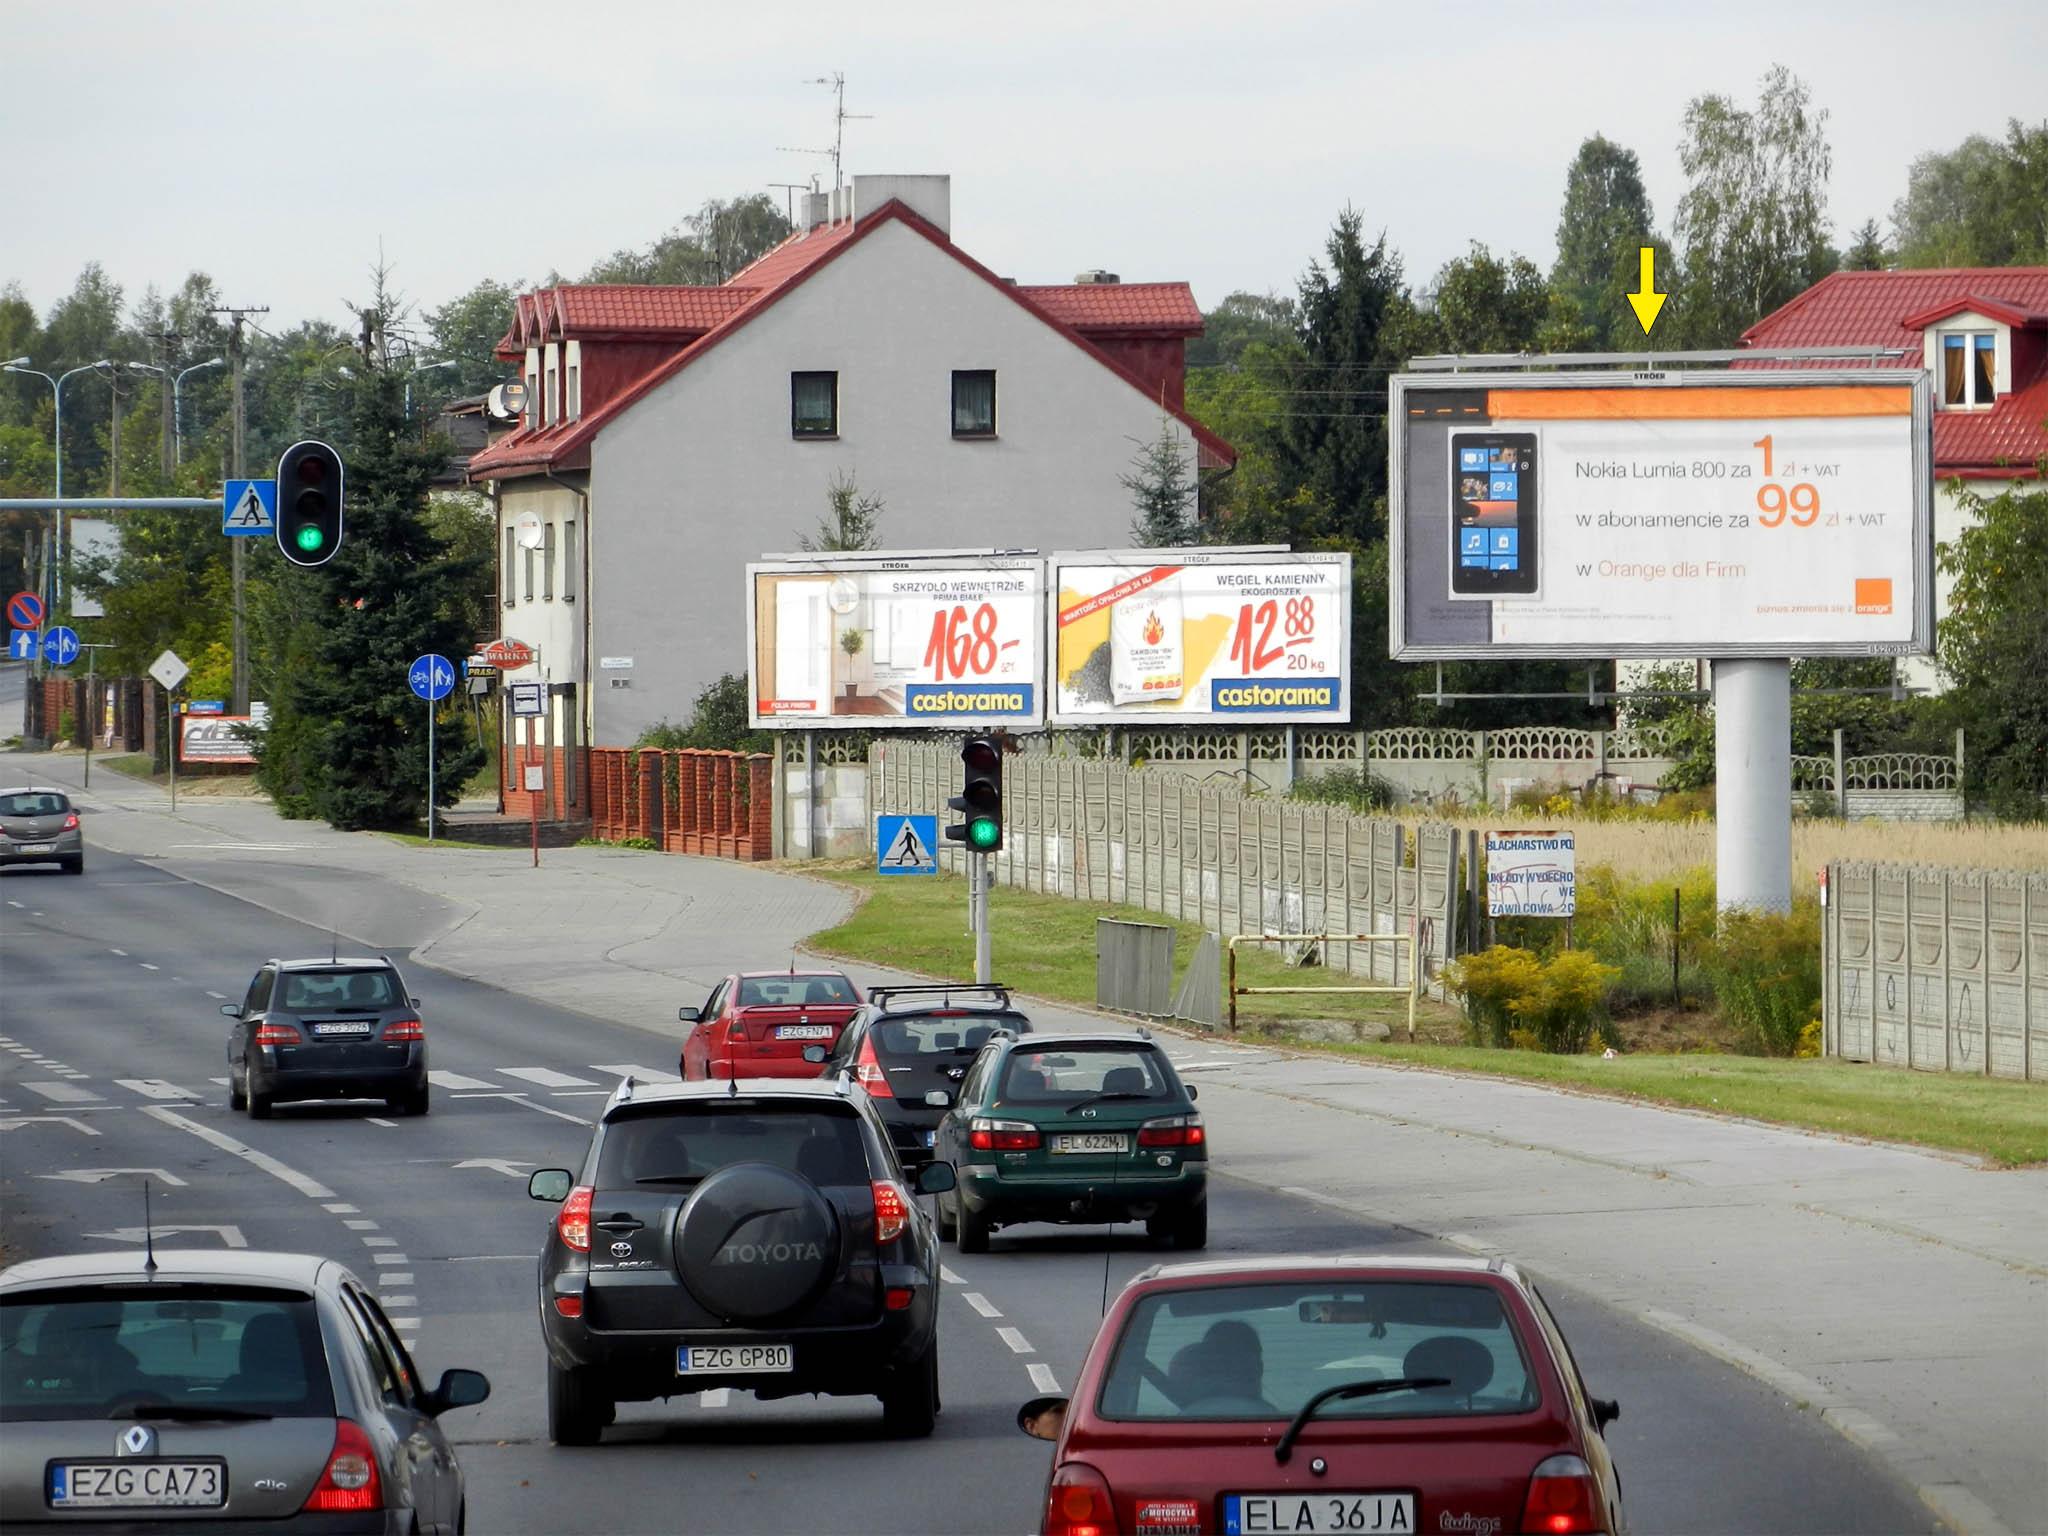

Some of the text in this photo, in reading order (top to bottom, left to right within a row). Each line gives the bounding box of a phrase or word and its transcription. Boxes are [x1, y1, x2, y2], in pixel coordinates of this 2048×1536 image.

[1576, 461, 1627, 478] Nokia
[1633, 461, 1687, 478] Lumia
[1692, 461, 1726, 478] 800
[1731, 464, 1752, 478] za
[1753, 434, 1774, 477] 1
[1801, 464, 1811, 474] +
[1814, 463, 1841, 477] VAT
[1576, 513, 1592, 527] w
[1598, 509, 1723, 528] abonamencie
[1728, 513, 1750, 528] za
[1756, 482, 1821, 528] 99
[1845, 514, 1855, 525] +
[1859, 513, 1887, 527] VAT
[1576, 559, 1746, 582] w Orange dla Firm
[950, 580, 1025, 593] WEWNĘTRZNE
[1216, 573, 1326, 587] WĘGIEL KAMIENNY
[1241, 587, 1301, 597] EKOGROSZEK
[1857, 603, 1890, 615] orange
[1230, 599, 1285, 675] 12
[1285, 595, 1315, 637] 88
[487, 652, 529, 661] WARKA
[1286, 654, 1326, 672] 20 kg
[468, 668, 497, 676] PRASA
[912, 690, 1024, 711] castorama
[1217, 684, 1331, 707] castorama
[1486, 839, 1559, 851] BLACHARSTWO
[1558, 886, 1575, 897] WE
[1491, 903, 1554, 914] ZAWILCOWA
[782, 1026, 831, 1036] EZG FN71
[1059, 1135, 1126, 1150] EL 622MJ
[725, 1243, 822, 1263] TOYOTA
[691, 1347, 789, 1368] EZG GP80
[71, 1467, 217, 1497] EZG CA73
[1148, 1508, 1196, 1517] MOTOCYKLE
[1246, 1498, 1408, 1531] ELA 36JA
[1227, 1520, 1240, 1529] PL
